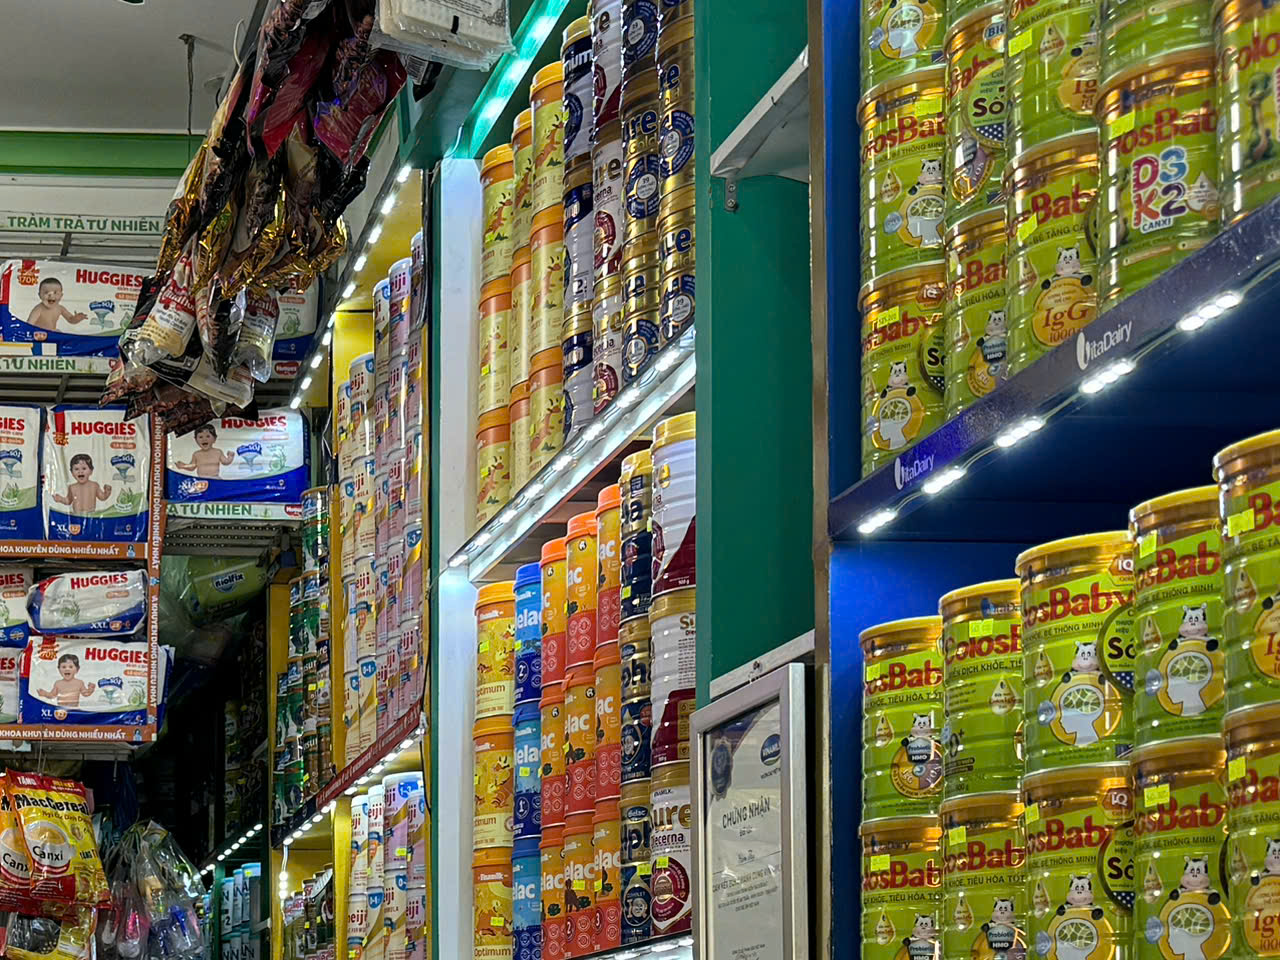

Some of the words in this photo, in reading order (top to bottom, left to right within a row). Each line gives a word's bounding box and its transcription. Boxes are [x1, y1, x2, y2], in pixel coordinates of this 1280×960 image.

[7, 213, 51, 229] TRÀM
[54, 215, 85, 230] TRÀ
[111, 217, 160, 232] NHIÊN
[1142, 217, 1172, 233] CANXI
[75, 269, 144, 287] HUGGIES
[1077, 320, 1133, 371] VitaDairy
[71, 421, 136, 436] HUGGIES
[894, 451, 934, 490] VitaDairy
[14, 544, 47, 554] KHUYÊN
[48, 545, 70, 555] DÙNG
[71, 573, 128, 590] HUGGIES
[1190, 583, 1215, 595] MINH
[1081, 620, 1105, 630] MINH
[85, 647, 149, 664] HUGGIES
[41, 709, 52, 717] XL
[16, 794, 89, 816] MacCereal
[723, 805, 747, 829] CHỨNG
[749, 796, 771, 819] NHẬN
[32, 845, 64, 862] Canxi
